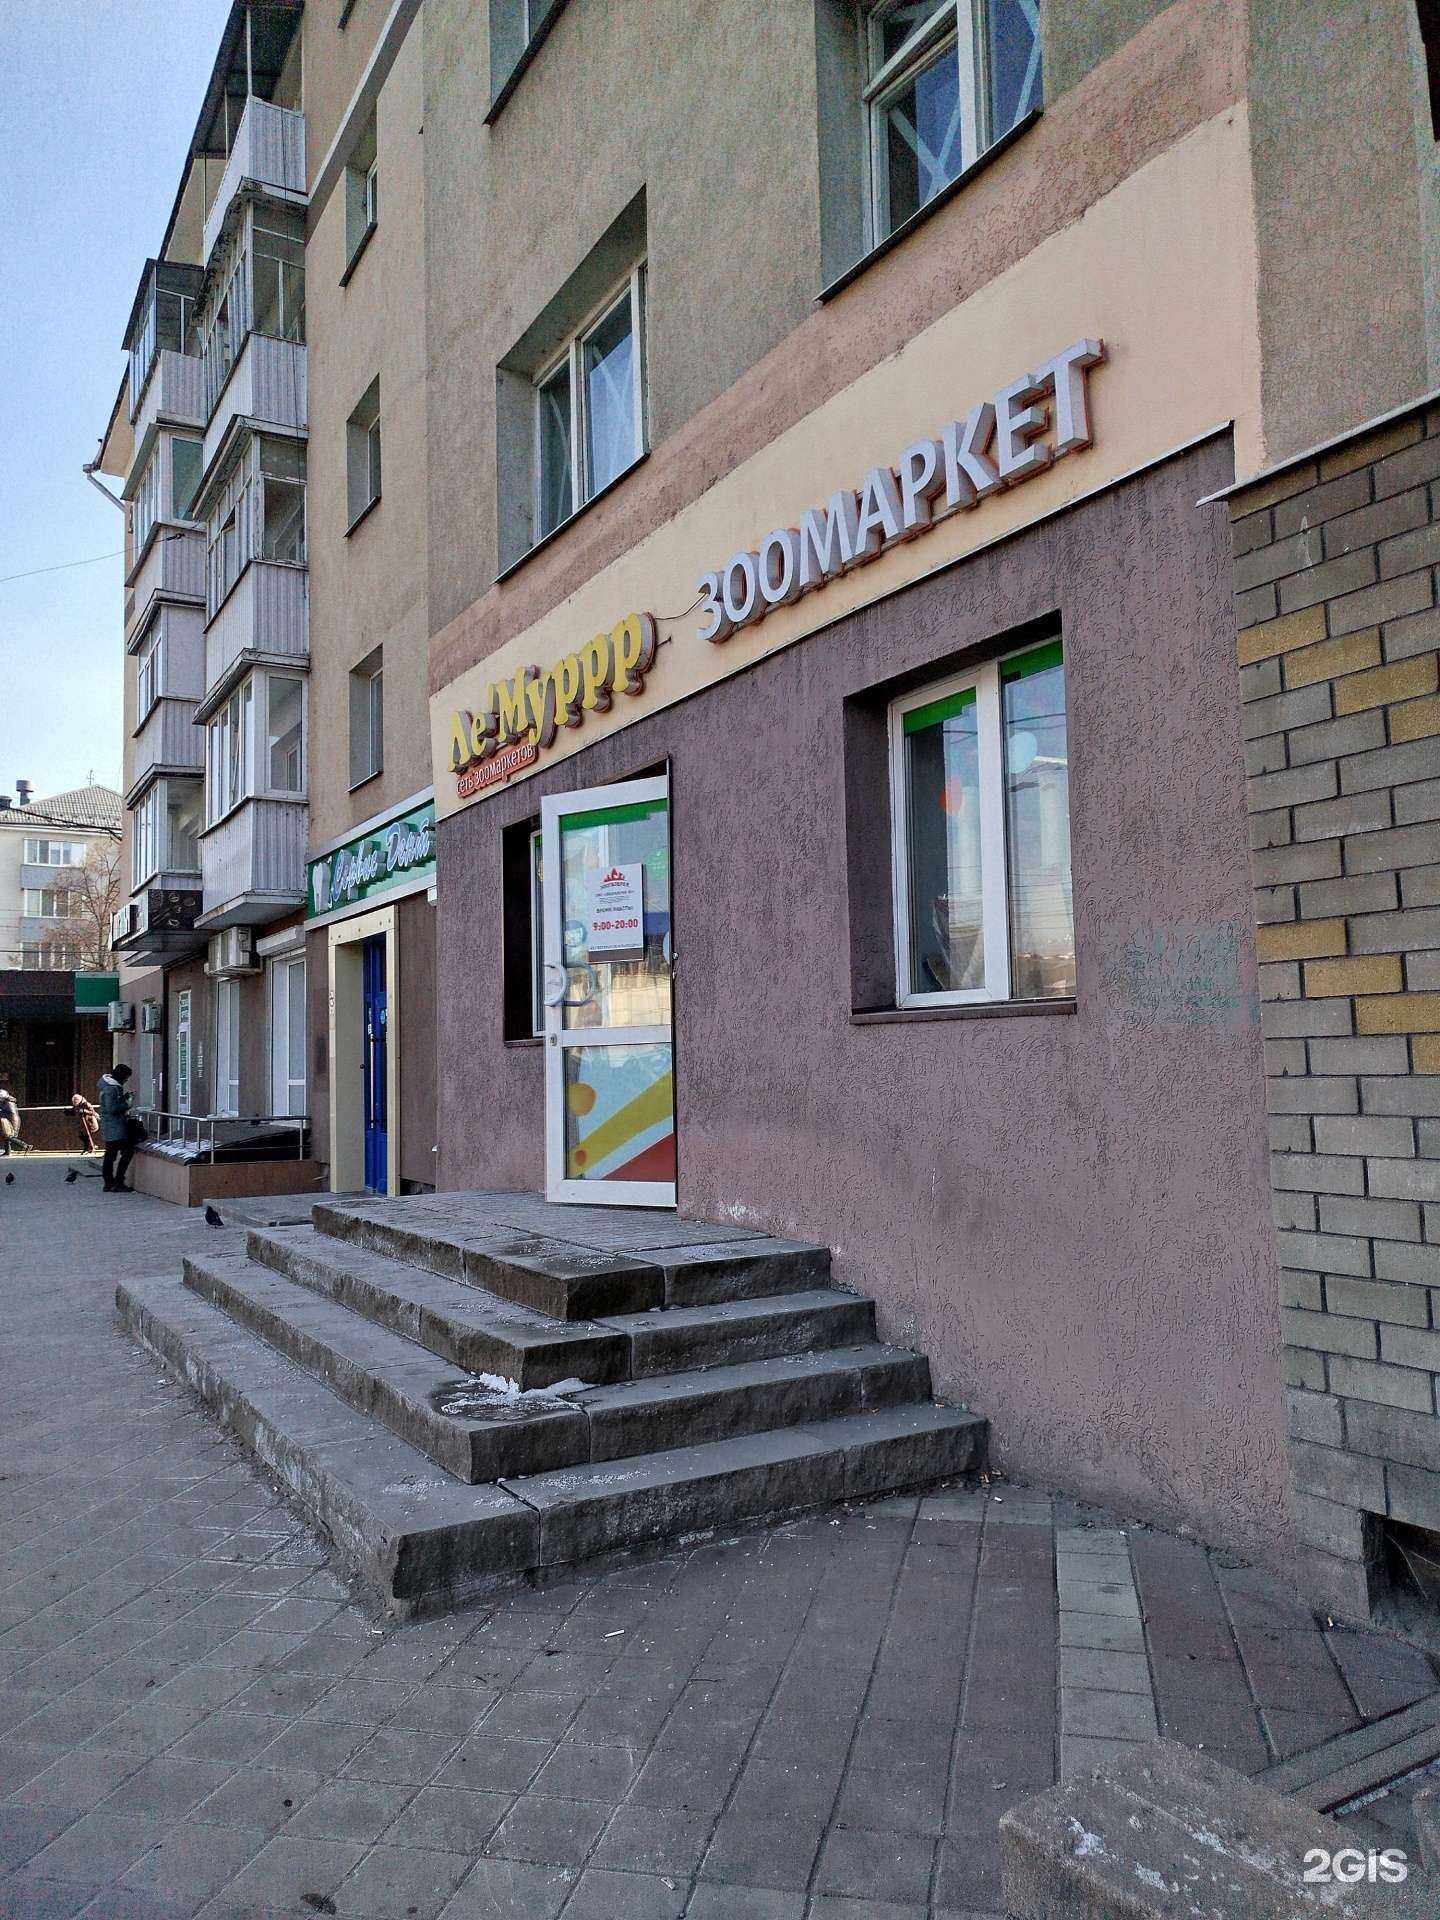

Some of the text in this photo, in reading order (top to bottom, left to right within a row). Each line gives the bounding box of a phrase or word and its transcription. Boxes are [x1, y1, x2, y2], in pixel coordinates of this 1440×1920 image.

[697, 339, 1100, 642] ЗООМАРКЕТ
[456, 743, 533, 793] сеть зоомаркетов
[593, 919, 639, 931] 9:00-20:00
